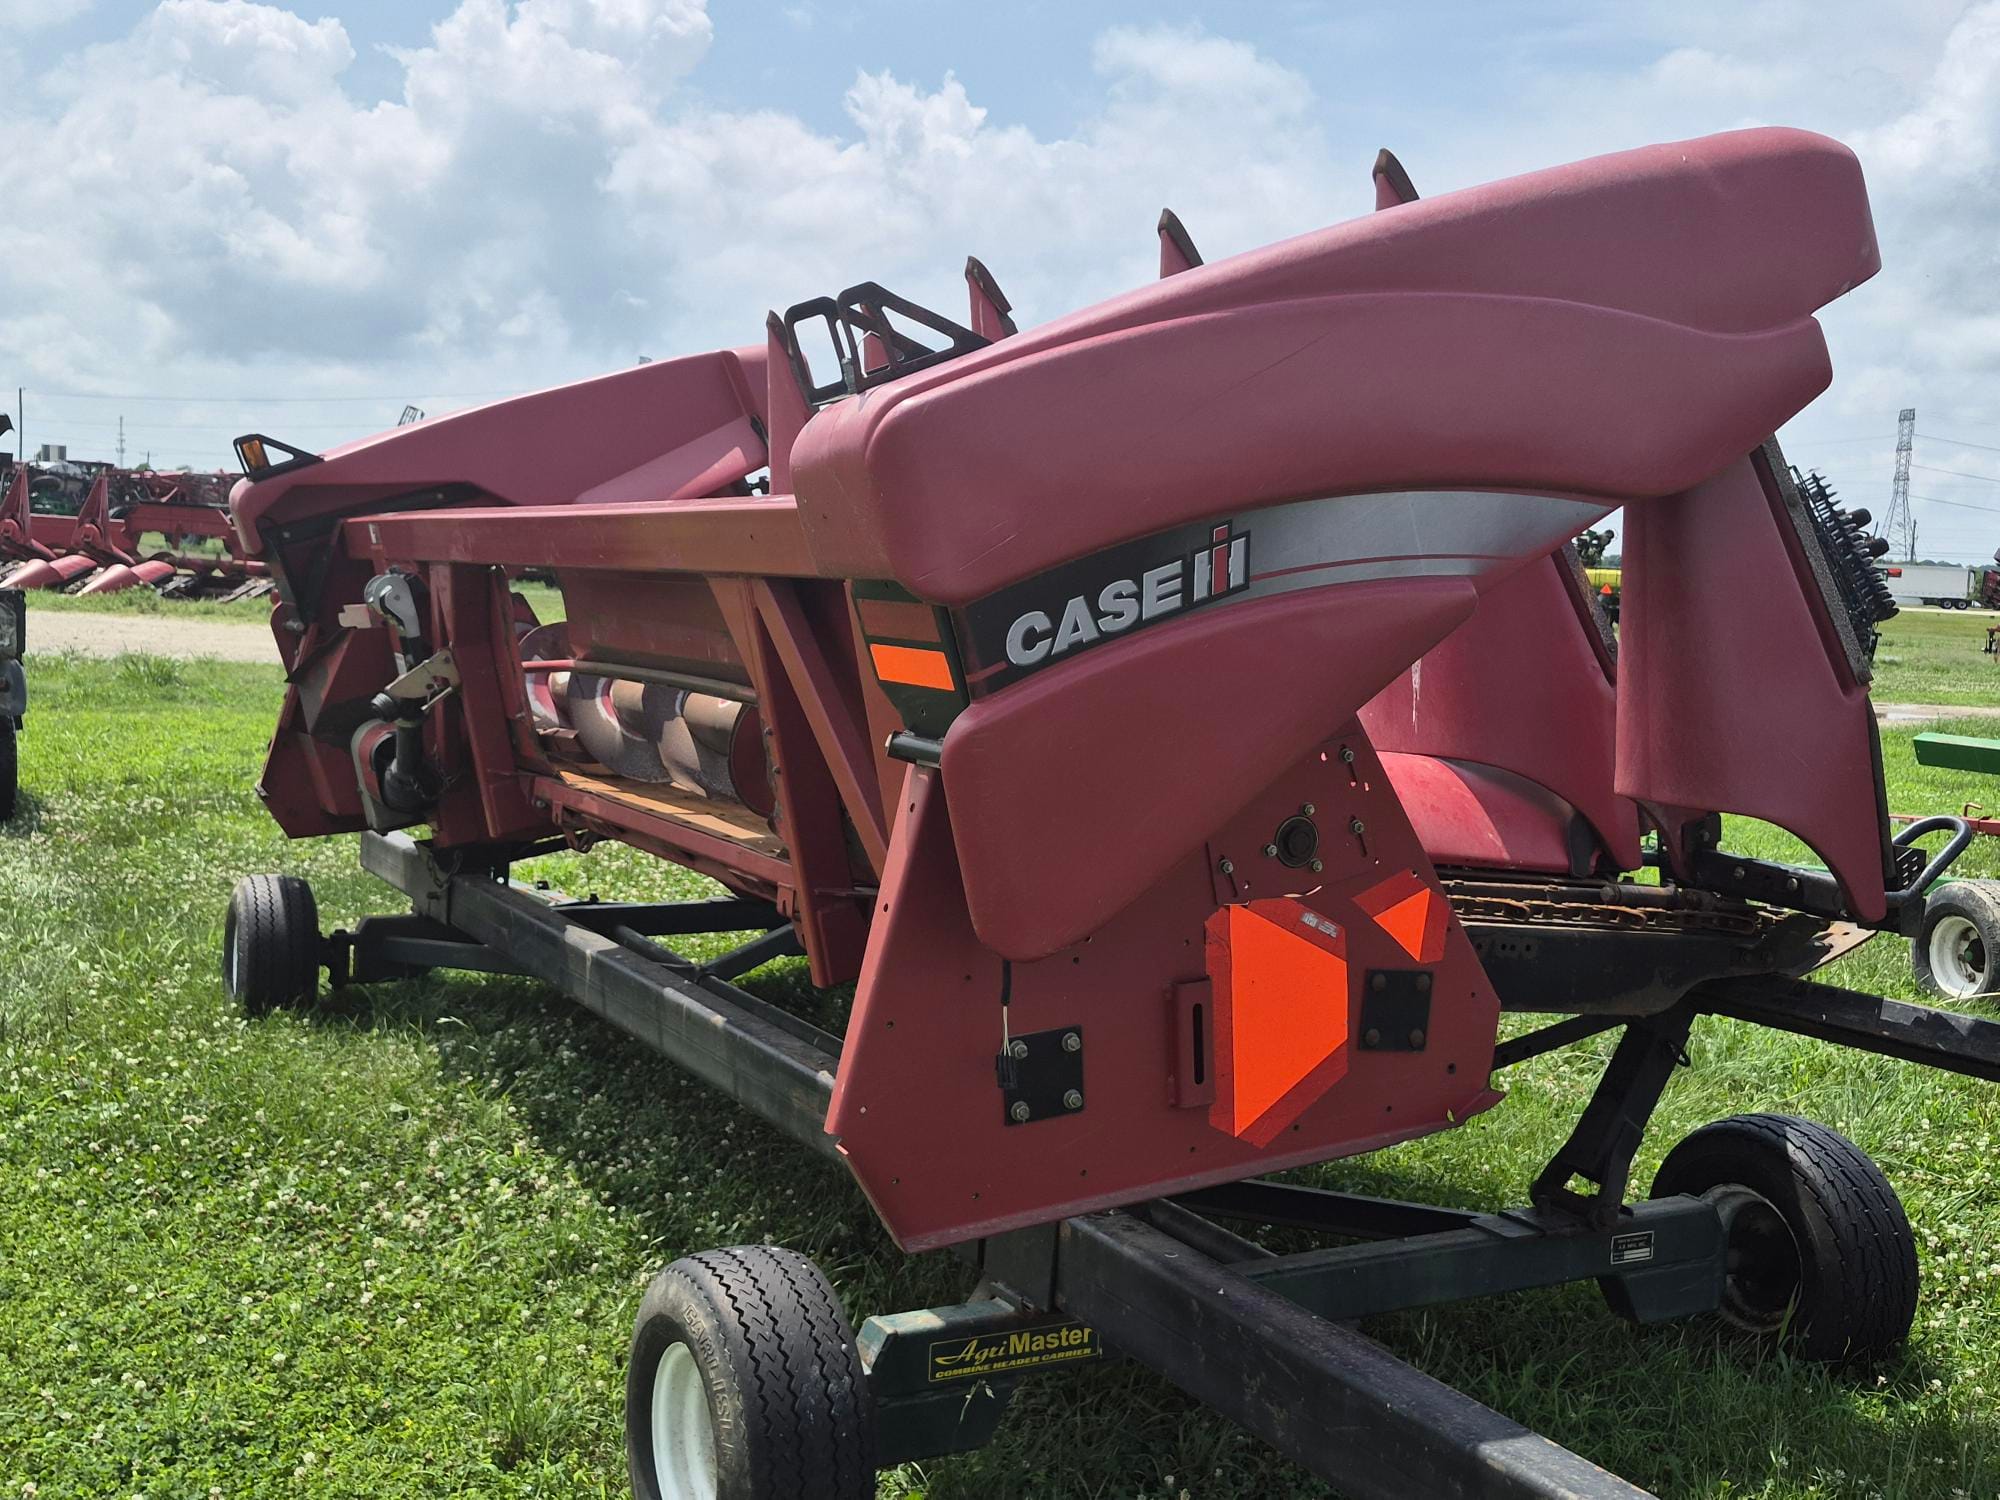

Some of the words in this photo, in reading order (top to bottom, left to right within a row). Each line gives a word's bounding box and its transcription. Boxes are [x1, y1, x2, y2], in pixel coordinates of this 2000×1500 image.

[1006, 559, 1184, 667] CASE
[1193, 524, 1248, 603] IH
[935, 1363, 991, 1379] COMBINE
[993, 1355, 1040, 1370] HEADER
[1040, 1346, 1093, 1364] CARRIER
